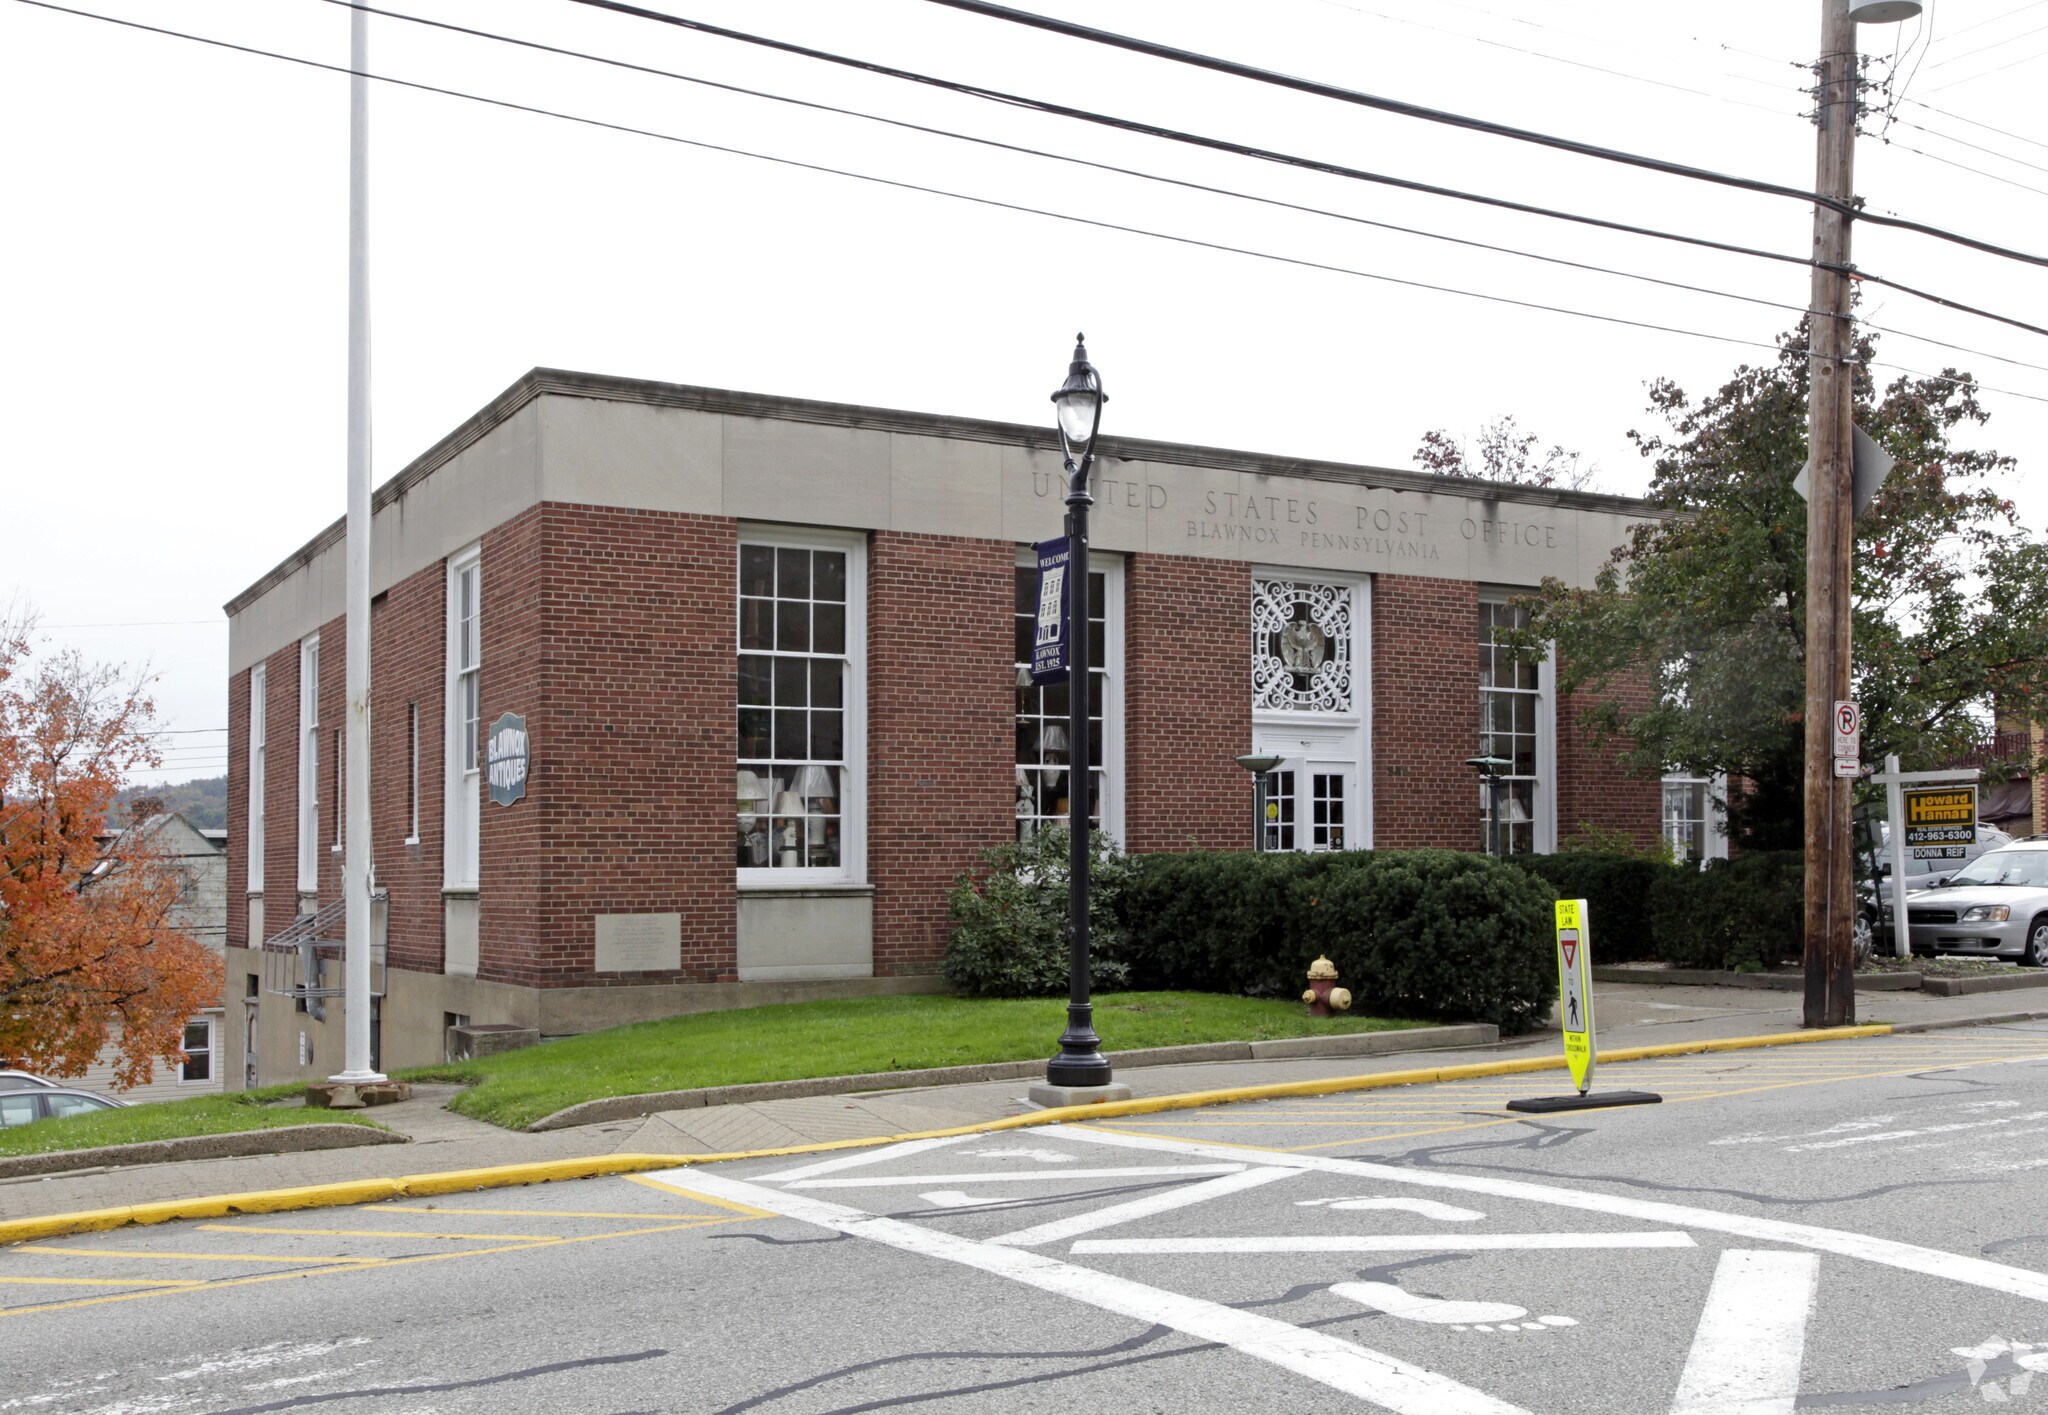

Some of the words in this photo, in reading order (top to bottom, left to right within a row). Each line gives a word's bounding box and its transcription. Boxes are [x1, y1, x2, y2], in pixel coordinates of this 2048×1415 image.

[1204, 490, 1318, 525] STATES
[1356, 506, 1428, 536] POST
[1460, 518, 1558, 549] OFFICE
[1187, 520, 1280, 544] BLAWNOX
[1300, 531, 1440, 560] PENNSYLVANIA
[1040, 551, 1069, 568] WELCOME
[1047, 658, 1060, 668] 1925
[489, 728, 526, 763] BLAWNOX
[489, 758, 526, 790] ANTIQUES
[1911, 793, 1969, 813] Howard
[1911, 804, 1960, 821] Hanna
[1908, 831, 1972, 841] 412-963-6300
[1915, 848, 1943, 858] DONNA
[1946, 847, 1964, 857] REIF
[1559, 904, 1575, 914] STATE
[1562, 916, 1573, 926] LAW
